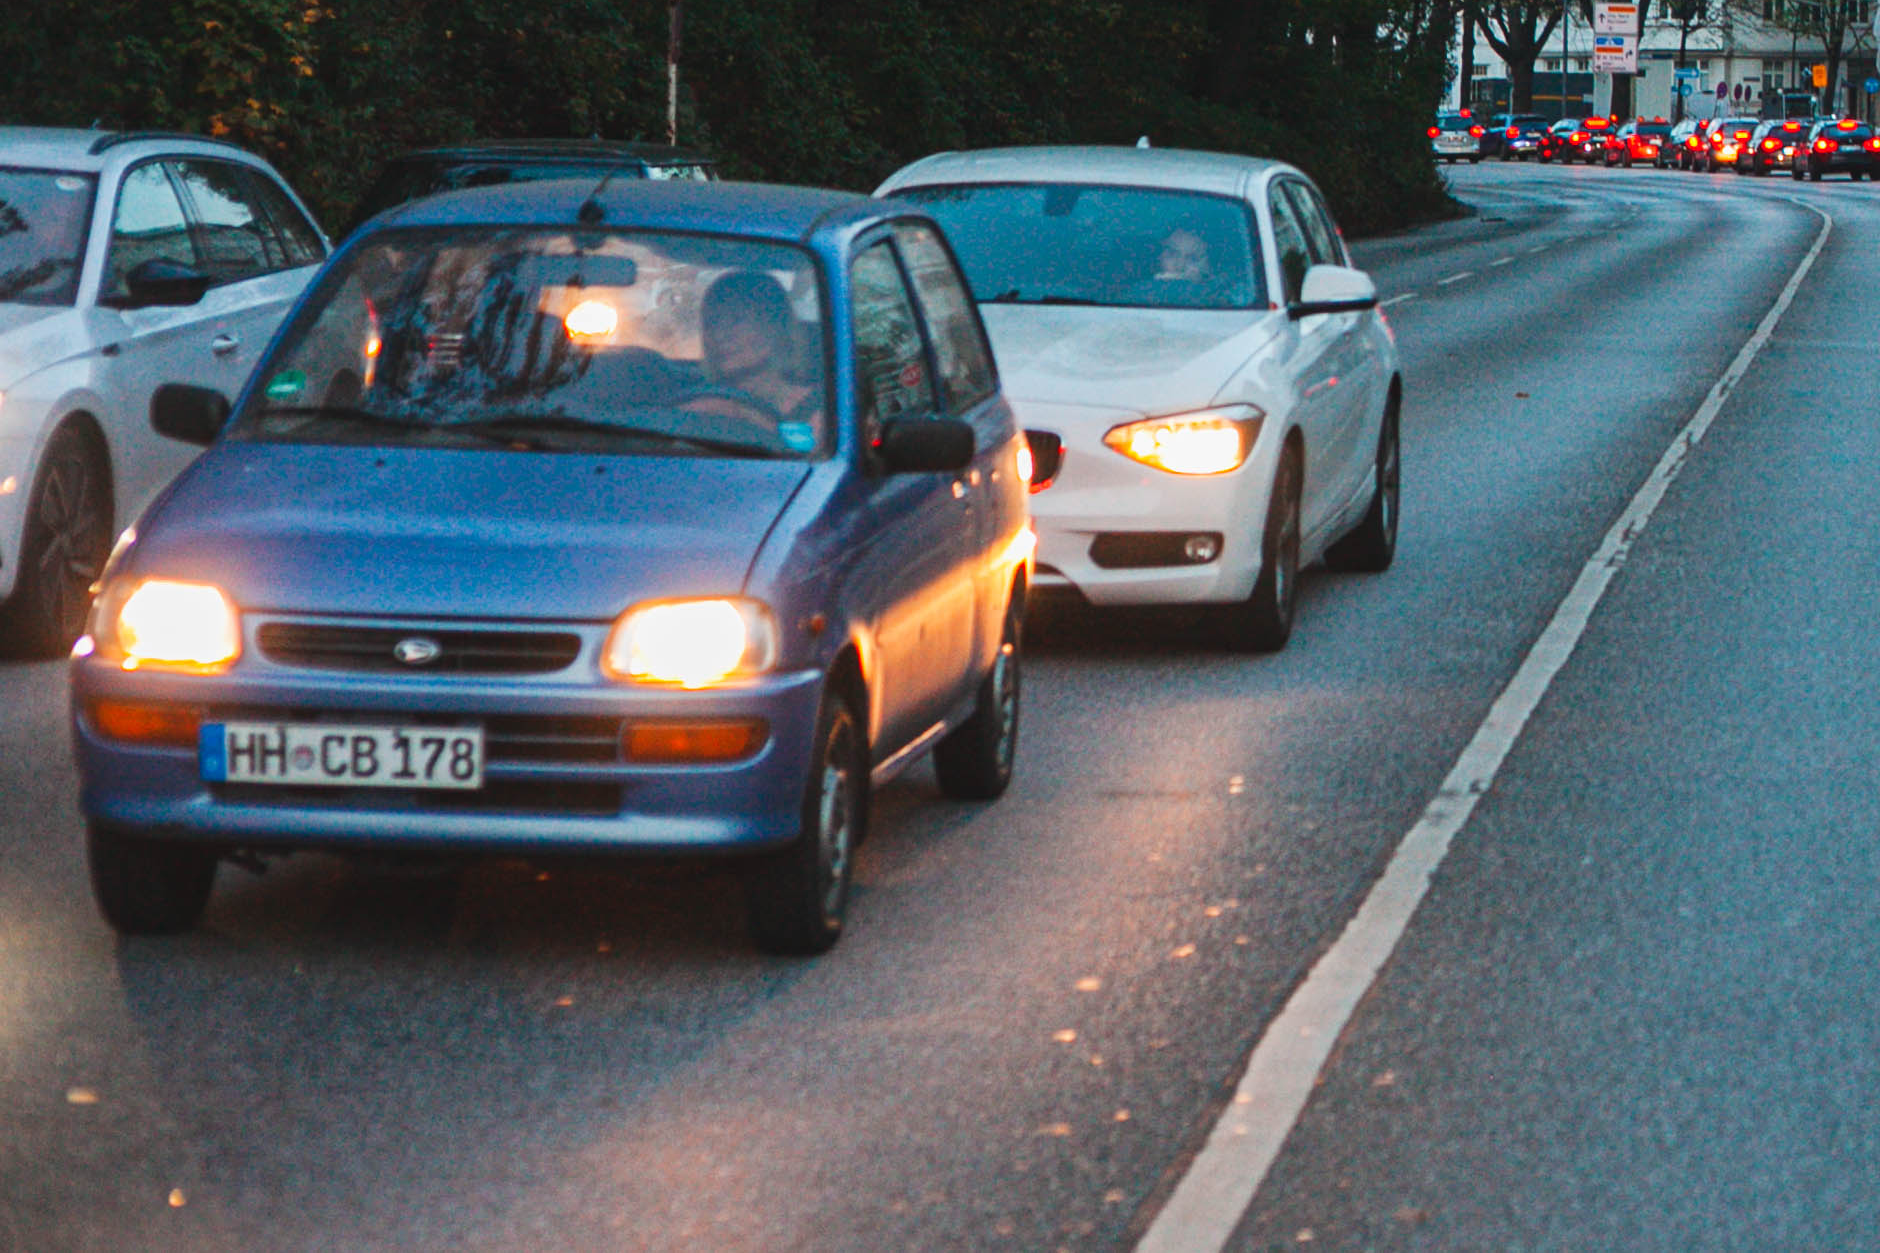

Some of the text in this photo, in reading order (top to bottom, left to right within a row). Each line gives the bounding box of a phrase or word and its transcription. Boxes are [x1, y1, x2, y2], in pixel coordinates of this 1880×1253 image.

[229, 731, 475, 781] HH CB 178
